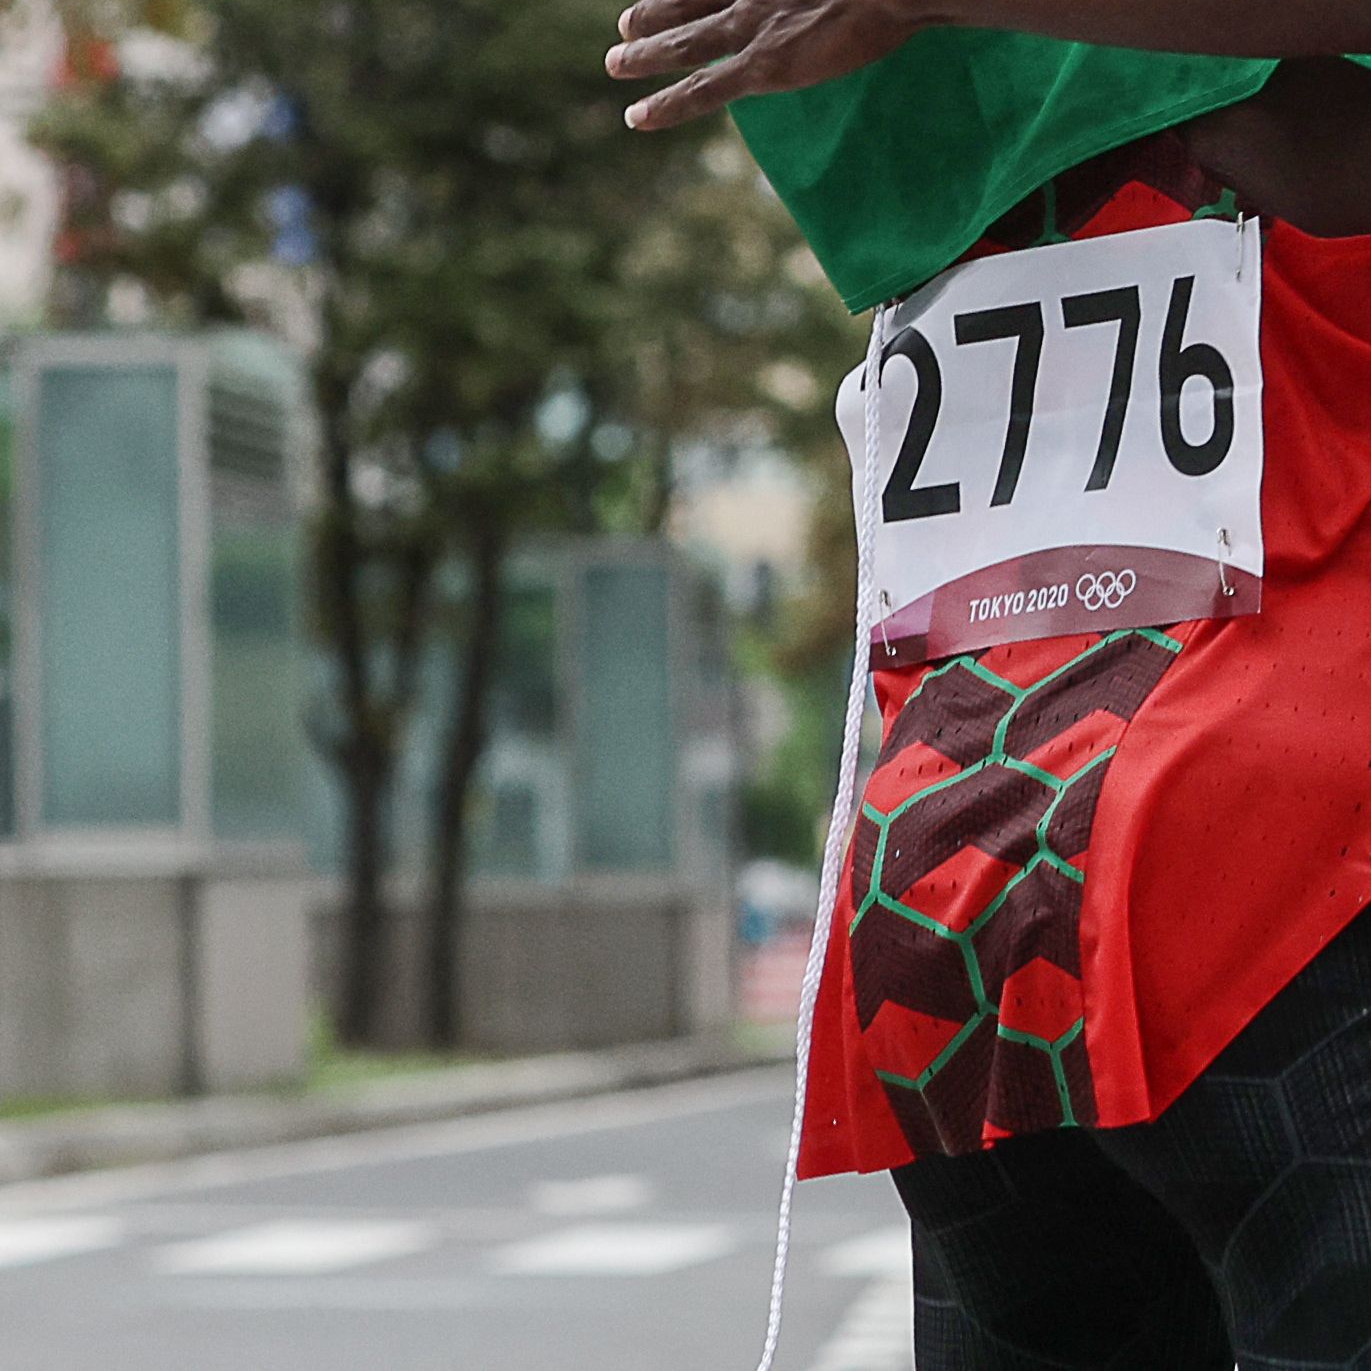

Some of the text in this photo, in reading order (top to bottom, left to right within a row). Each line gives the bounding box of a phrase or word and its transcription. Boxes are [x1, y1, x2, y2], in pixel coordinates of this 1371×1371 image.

[860, 274, 1234, 524] 2776
[970, 583, 1068, 623] TOKYO 2020
